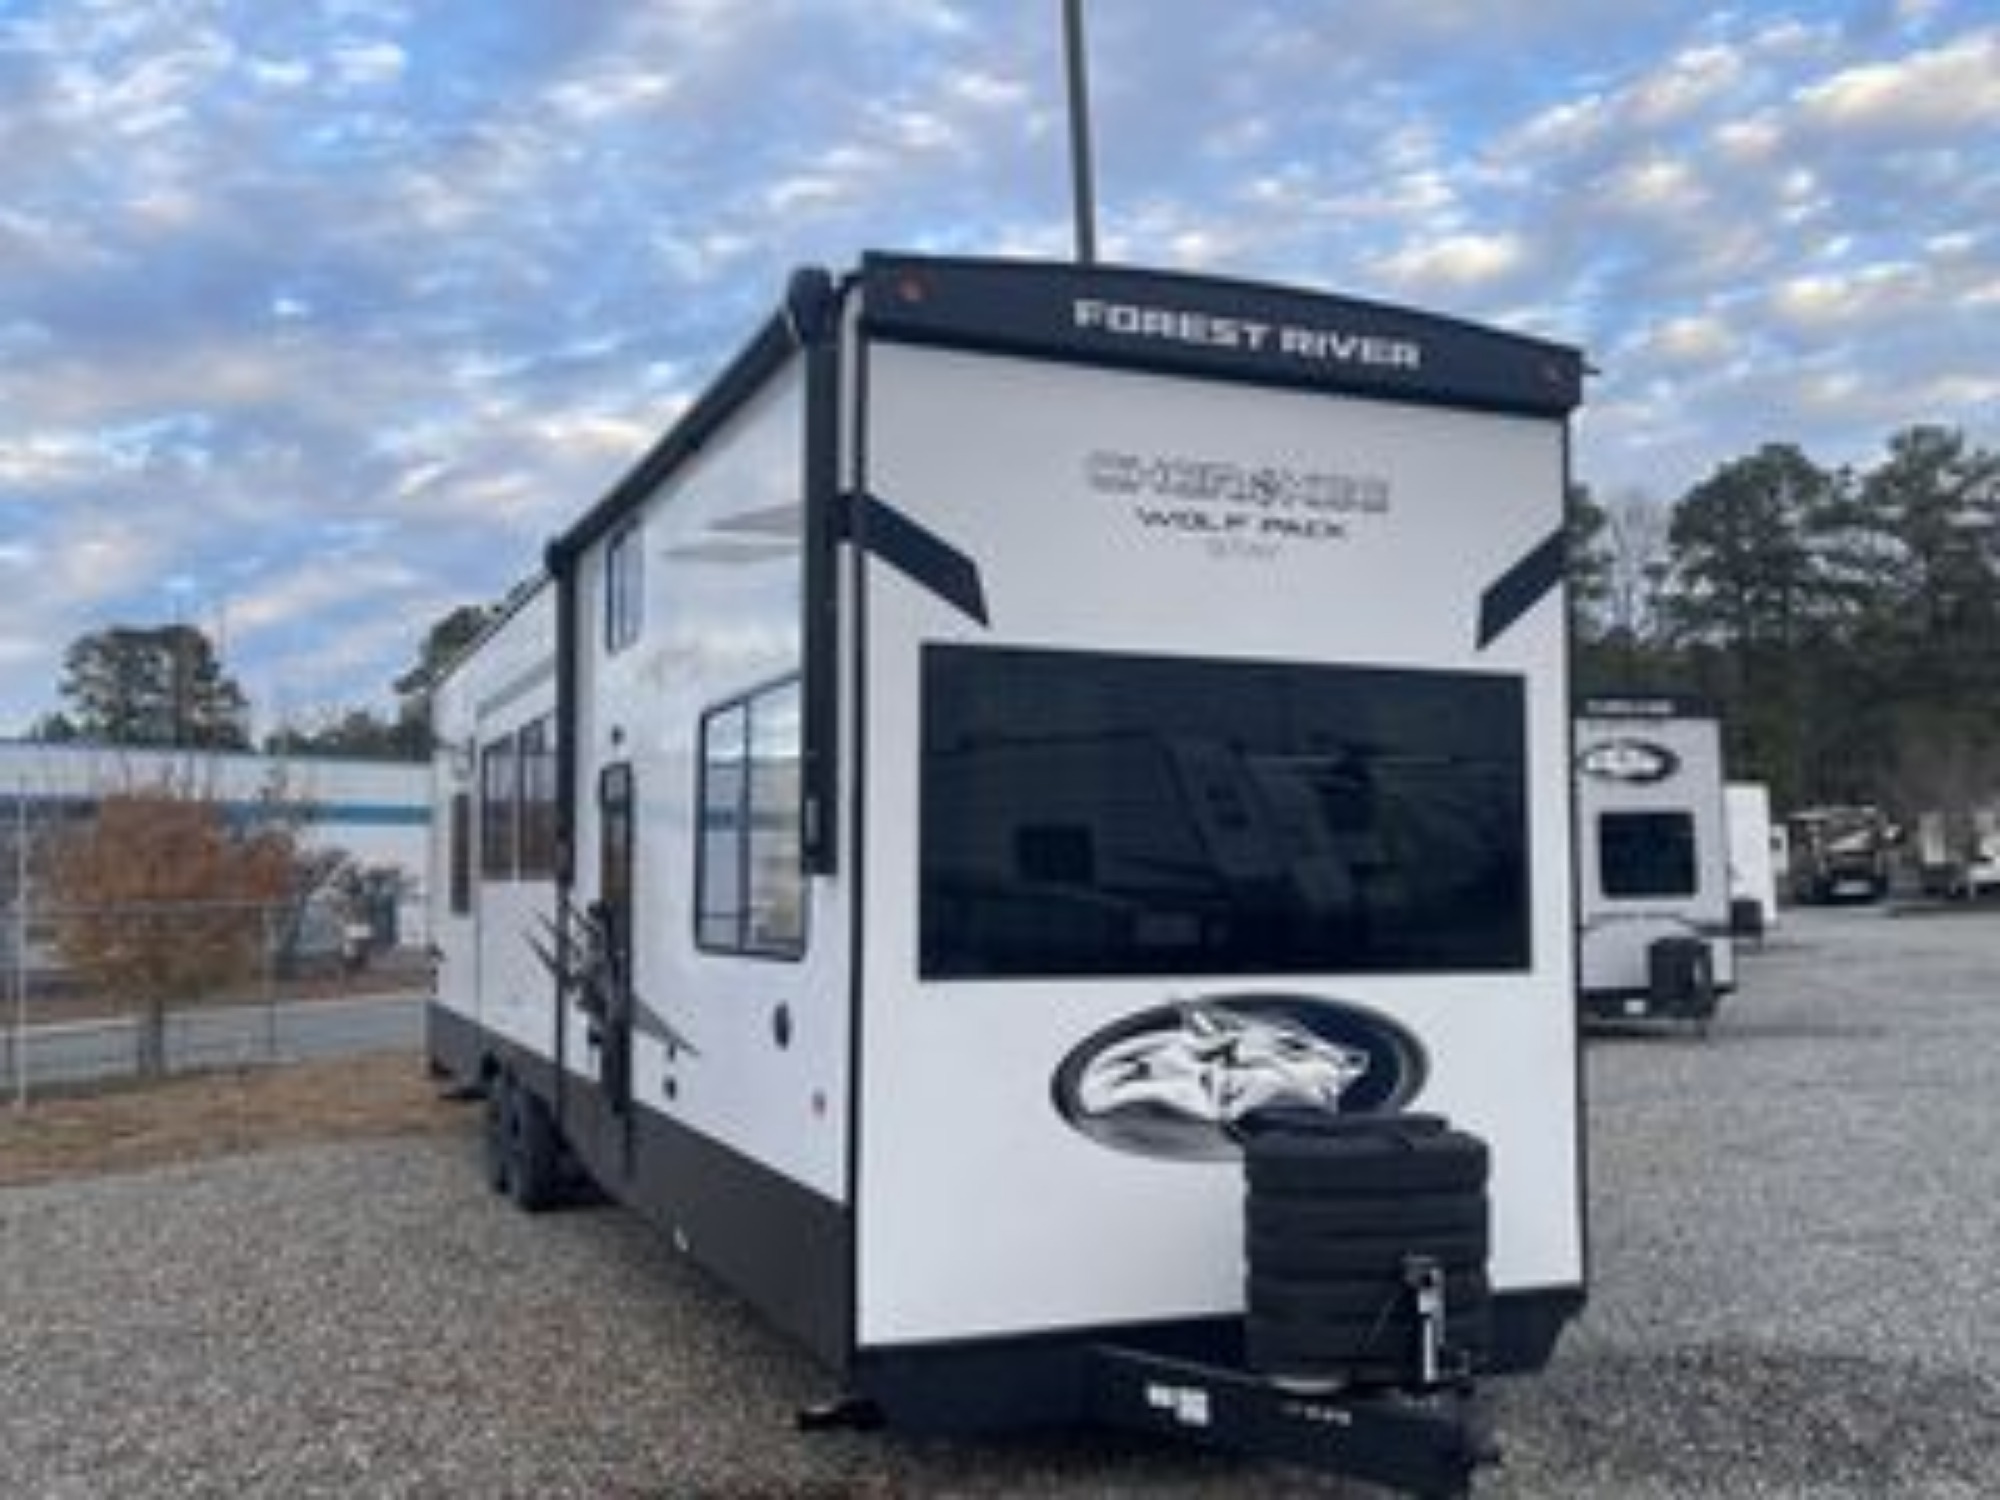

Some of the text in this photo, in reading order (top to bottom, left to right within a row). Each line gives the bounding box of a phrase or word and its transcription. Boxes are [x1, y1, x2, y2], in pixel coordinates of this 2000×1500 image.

[1073, 299, 1421, 370] FOREST RIVER
[1137, 505, 1252, 532] WOLF
